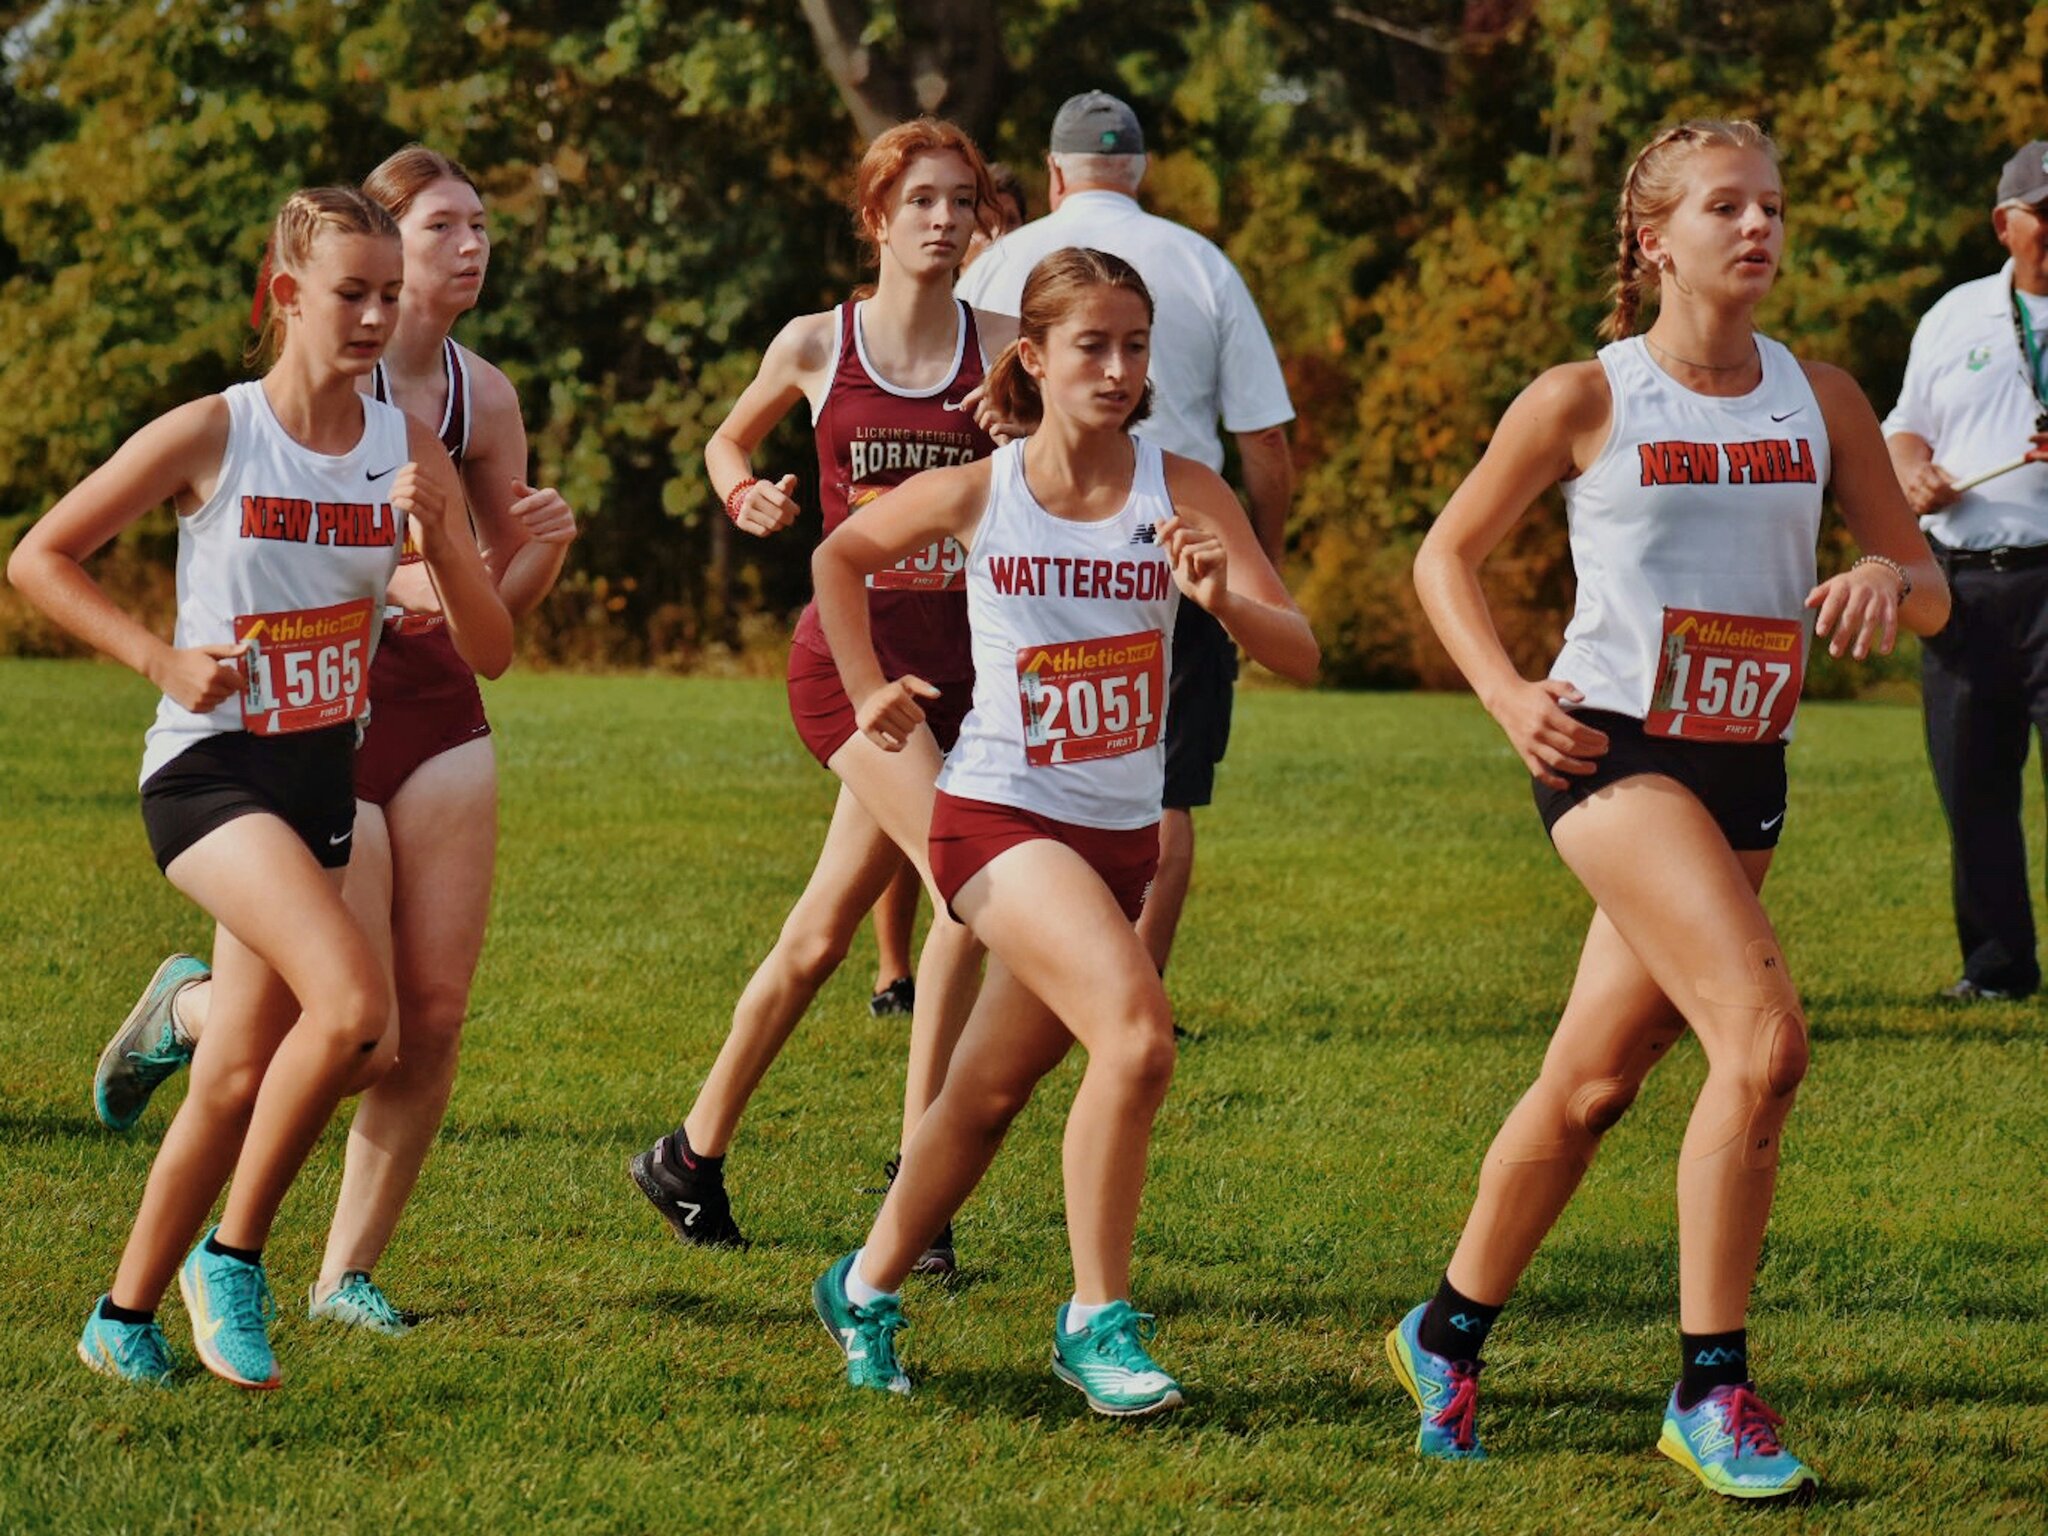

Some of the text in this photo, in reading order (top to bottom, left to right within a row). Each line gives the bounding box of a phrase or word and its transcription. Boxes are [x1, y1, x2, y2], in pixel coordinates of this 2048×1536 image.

[856, 426, 972, 445] LICKING HEIGHTS
[849, 441, 975, 482] HORNETS
[1638, 439, 1817, 487] NEW PHILA
[240, 495, 396, 547] NEW PHILA
[988, 556, 1171, 600] WATTERSON
[244, 639, 361, 714] 1565
[1668, 653, 1791, 720] 1567
[1022, 671, 1153, 747] 2051
[1725, 724, 1755, 735] FIRST
[1106, 735, 1134, 749] FIRST
